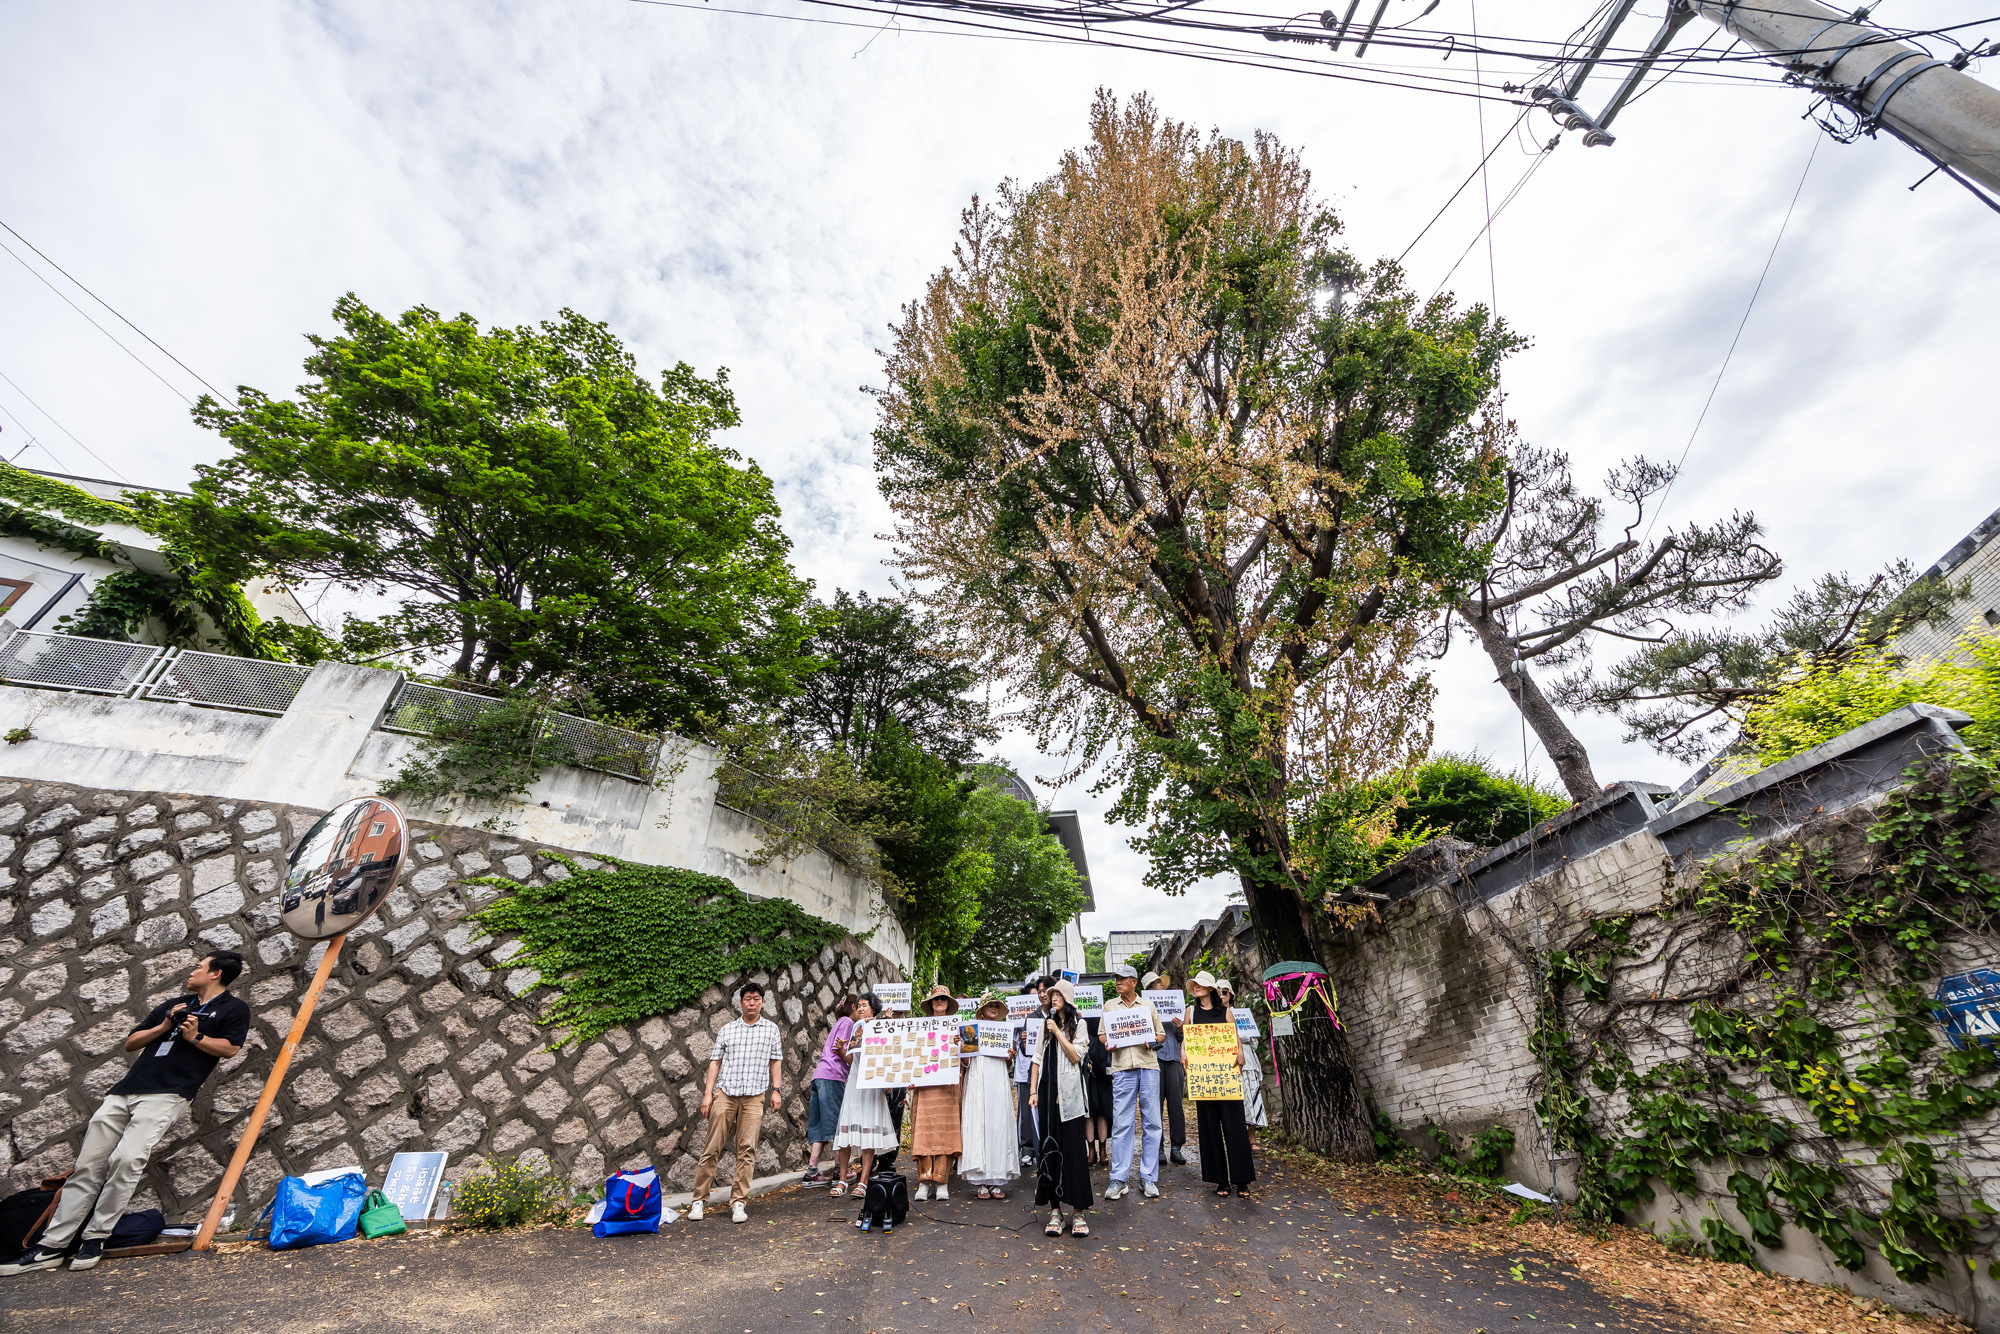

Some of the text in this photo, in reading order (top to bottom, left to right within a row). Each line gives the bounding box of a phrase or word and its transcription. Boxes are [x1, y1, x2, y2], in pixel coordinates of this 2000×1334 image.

[873, 1018, 959, 1034] 은행나무를 위한 마음
[1110, 1018, 1147, 1031] 환기미술관은
[1108, 1027, 1153, 1039] 책임있게 복원하라
[1189, 1063, 1202, 1073] 우리
[1189, 1074, 1204, 1085] 오래
[1205, 1073, 1231, 1085] 부암동을
[1190, 1084, 1242, 1097] 은행나무입니다!
[409, 1167, 430, 1204] 규탄한다!
